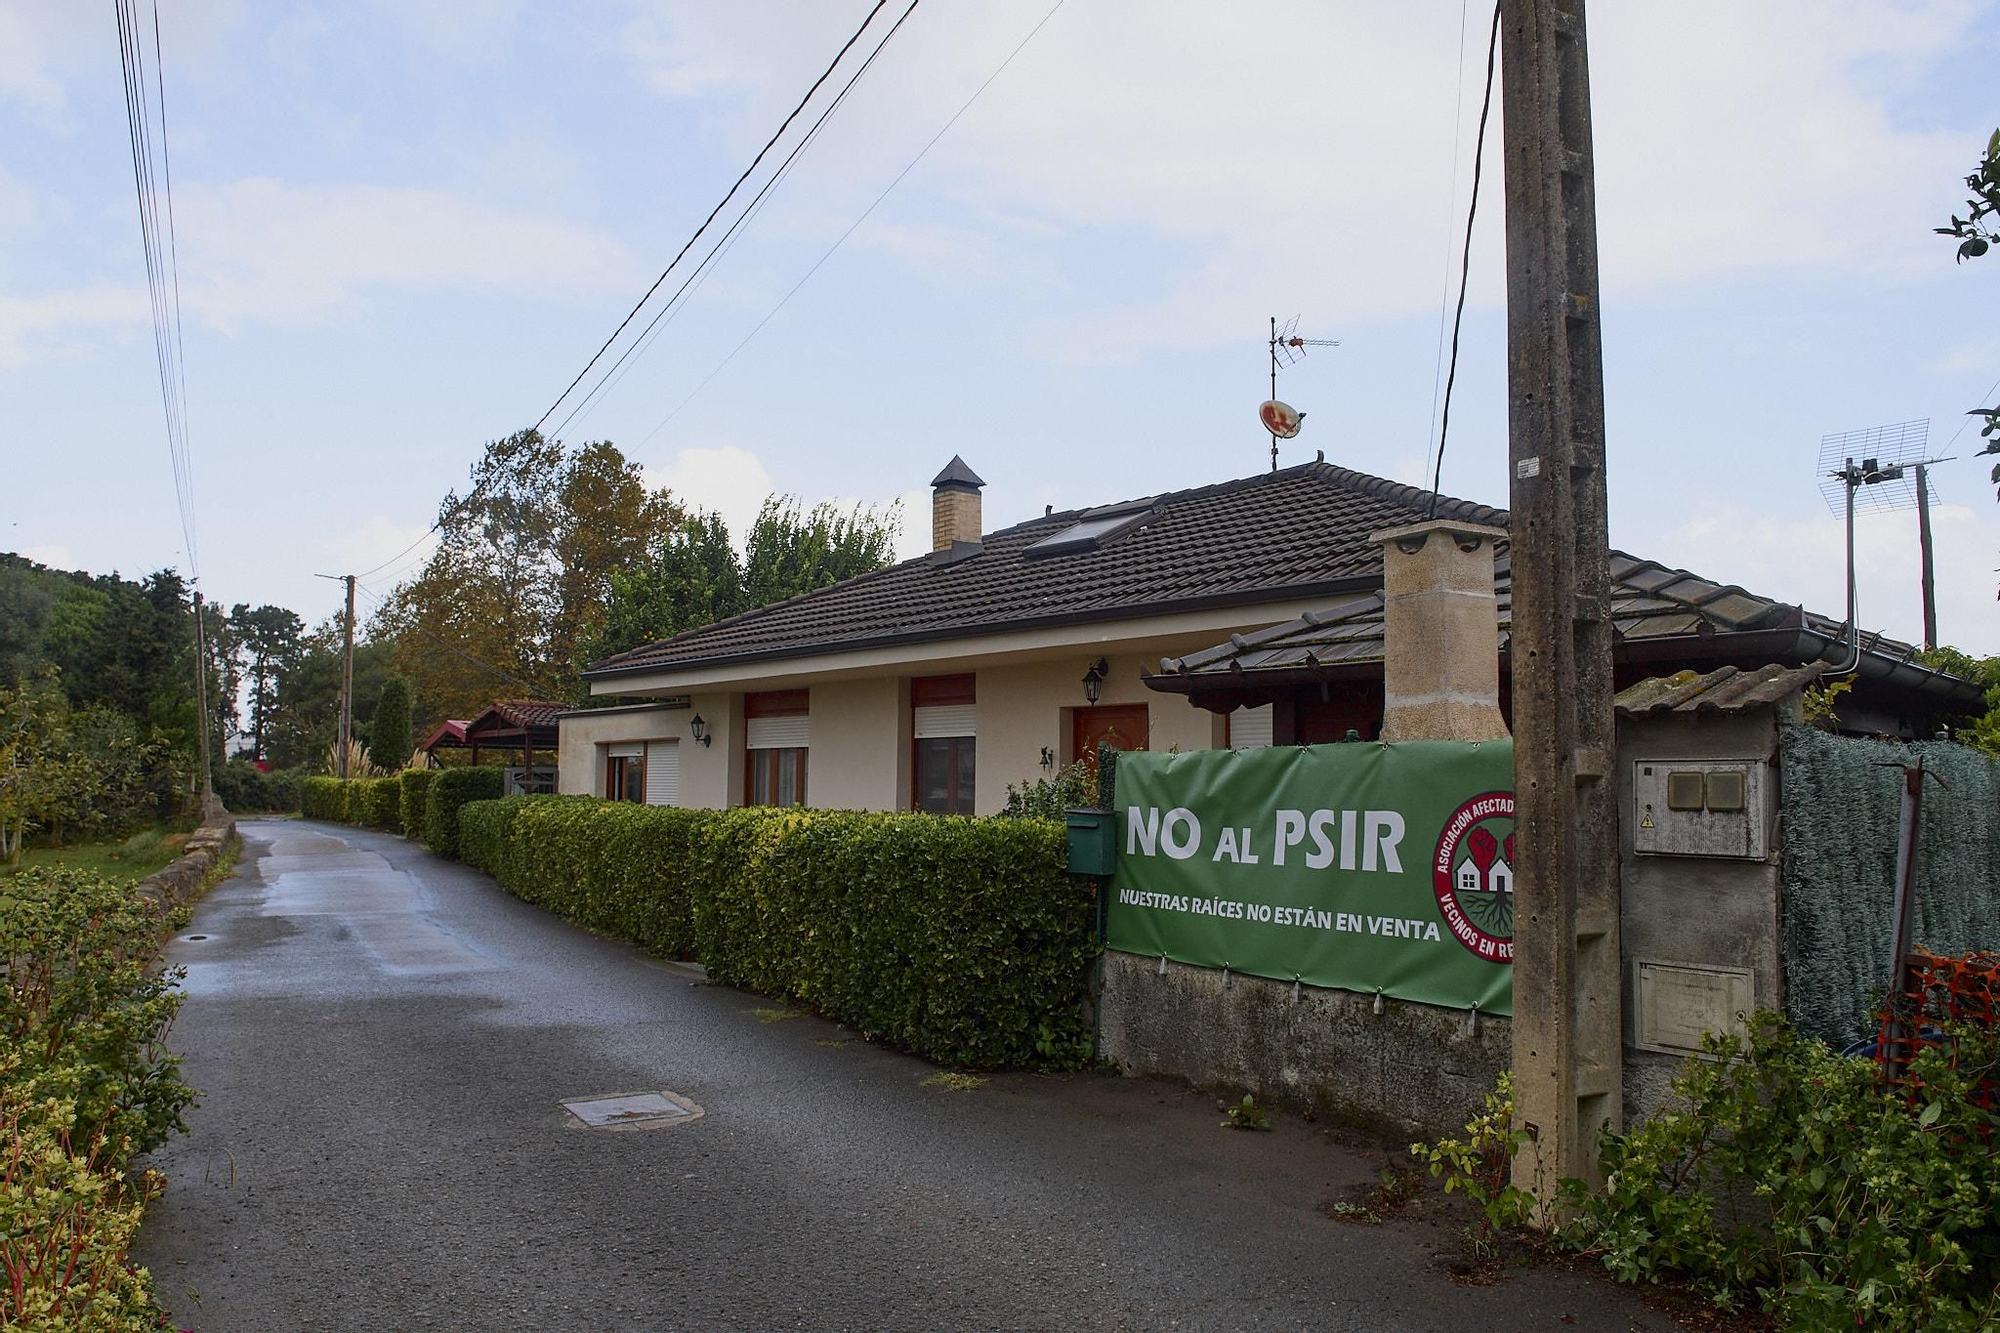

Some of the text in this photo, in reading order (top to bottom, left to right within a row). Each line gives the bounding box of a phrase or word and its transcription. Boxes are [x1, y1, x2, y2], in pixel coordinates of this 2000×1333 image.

[1126, 805, 1407, 874] NO AL PSIR
[1437, 810, 1473, 874] ASOCIACIÓN
[1119, 888, 1441, 942] NUESTRAS RAÍCES NO ESTÁN EN VENTA
[1440, 893, 1478, 946] VECINOS
[1478, 938, 1496, 956] EN
